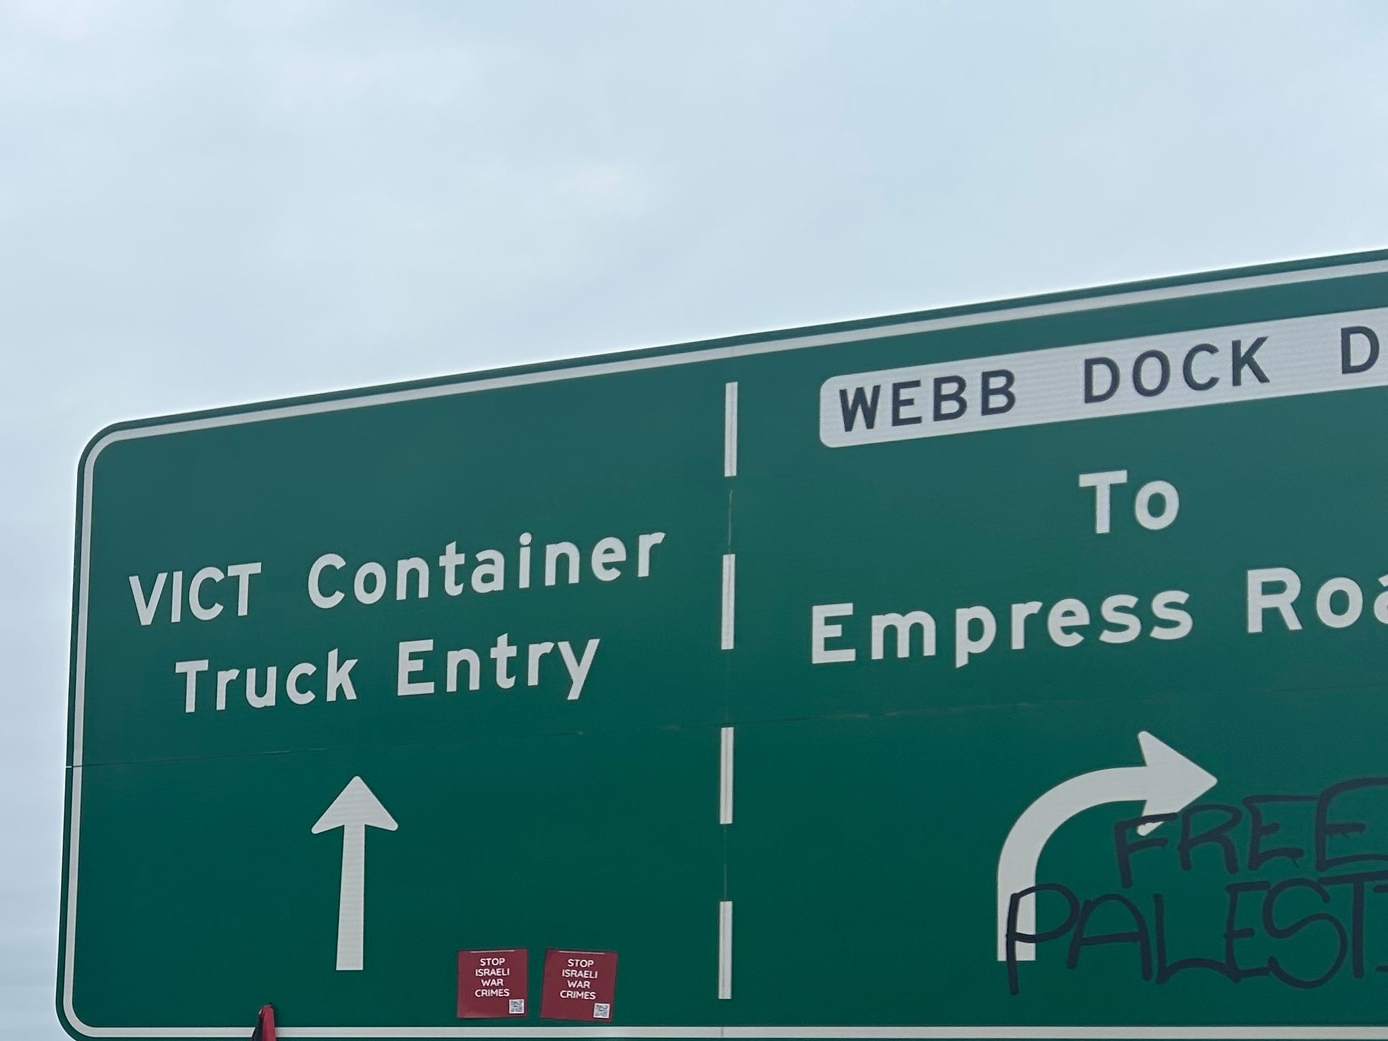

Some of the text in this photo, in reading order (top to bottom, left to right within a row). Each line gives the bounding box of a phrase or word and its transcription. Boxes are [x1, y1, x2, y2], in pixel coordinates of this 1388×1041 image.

[839, 369, 1016, 433] WEBB
[1084, 336, 1270, 404] DOCK
[1078, 470, 1179, 534] To
[127, 532, 665, 626] VICT Container
[812, 590, 1193, 668] Empress
[175, 633, 600, 713] Truck Entry
[1115, 777, 1388, 888] FREE
[479, 957, 506, 967] STOP
[567, 958, 595, 968] STOP
[475, 967, 510, 977] ISRAELI
[561, 969, 598, 979] ISRAELI
[480, 978, 504, 987] WAR
[567, 980, 591, 989] WAR
[474, 988, 510, 998] CRIMES
[559, 990, 597, 1000] CRIMES
